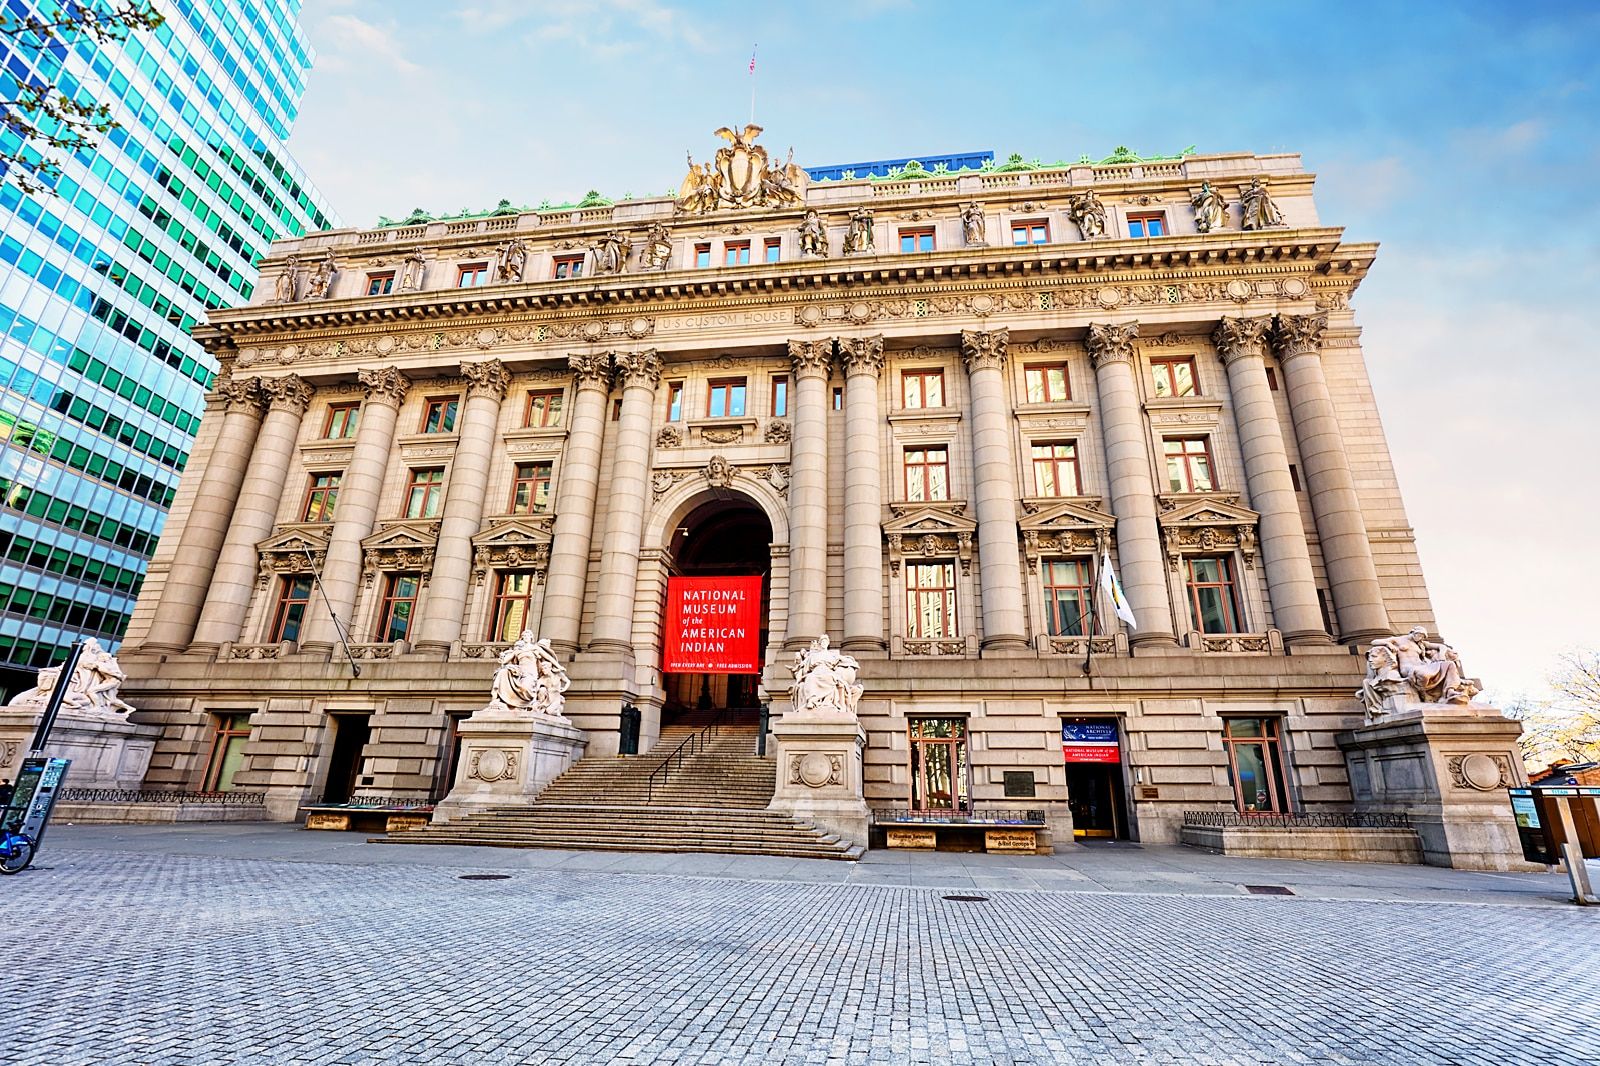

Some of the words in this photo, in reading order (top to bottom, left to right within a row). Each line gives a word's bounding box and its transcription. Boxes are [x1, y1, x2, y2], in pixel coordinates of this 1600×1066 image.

[685, 314, 737, 327] CUSTOM
[743, 311, 787, 323] HOUSE
[683, 590, 746, 601] NATIONAL
[682, 604, 737, 614] MUSEUM
[682, 616, 690, 627] of
[691, 617, 703, 625] the
[681, 628, 745, 638] AMERICAN
[680, 642, 725, 652] INDIAN
